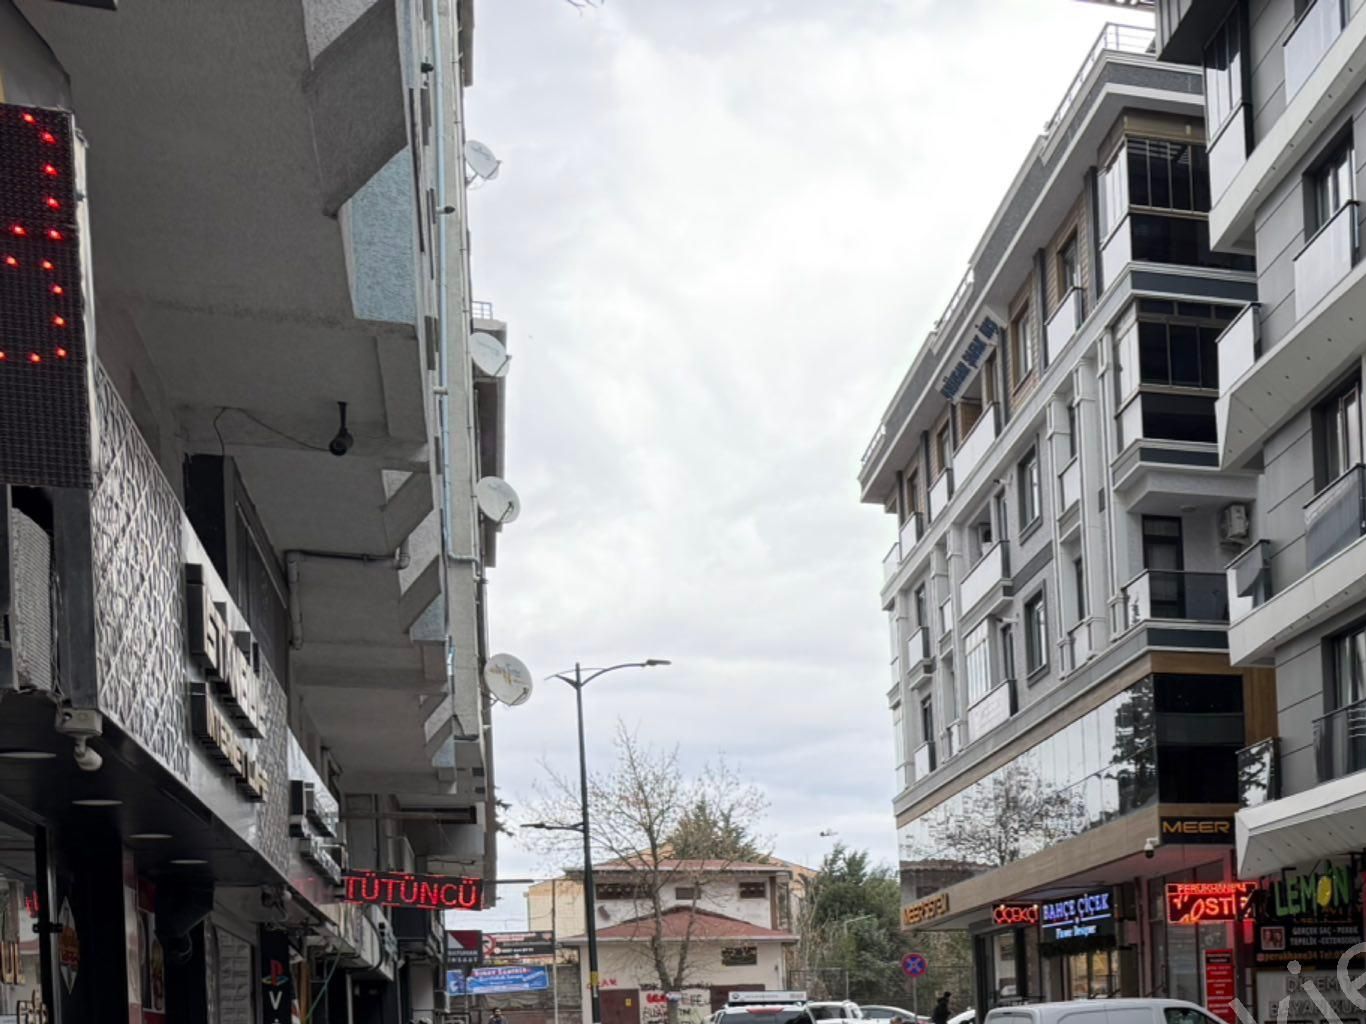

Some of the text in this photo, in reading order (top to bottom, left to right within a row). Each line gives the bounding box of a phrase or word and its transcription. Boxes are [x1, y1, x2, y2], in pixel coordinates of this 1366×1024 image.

[1162, 821, 1230, 834] MEER
[345, 873, 477, 907] TÜTÜNCÜ
[1042, 893, 1109, 919] BAHÇE ÇİÇEK
